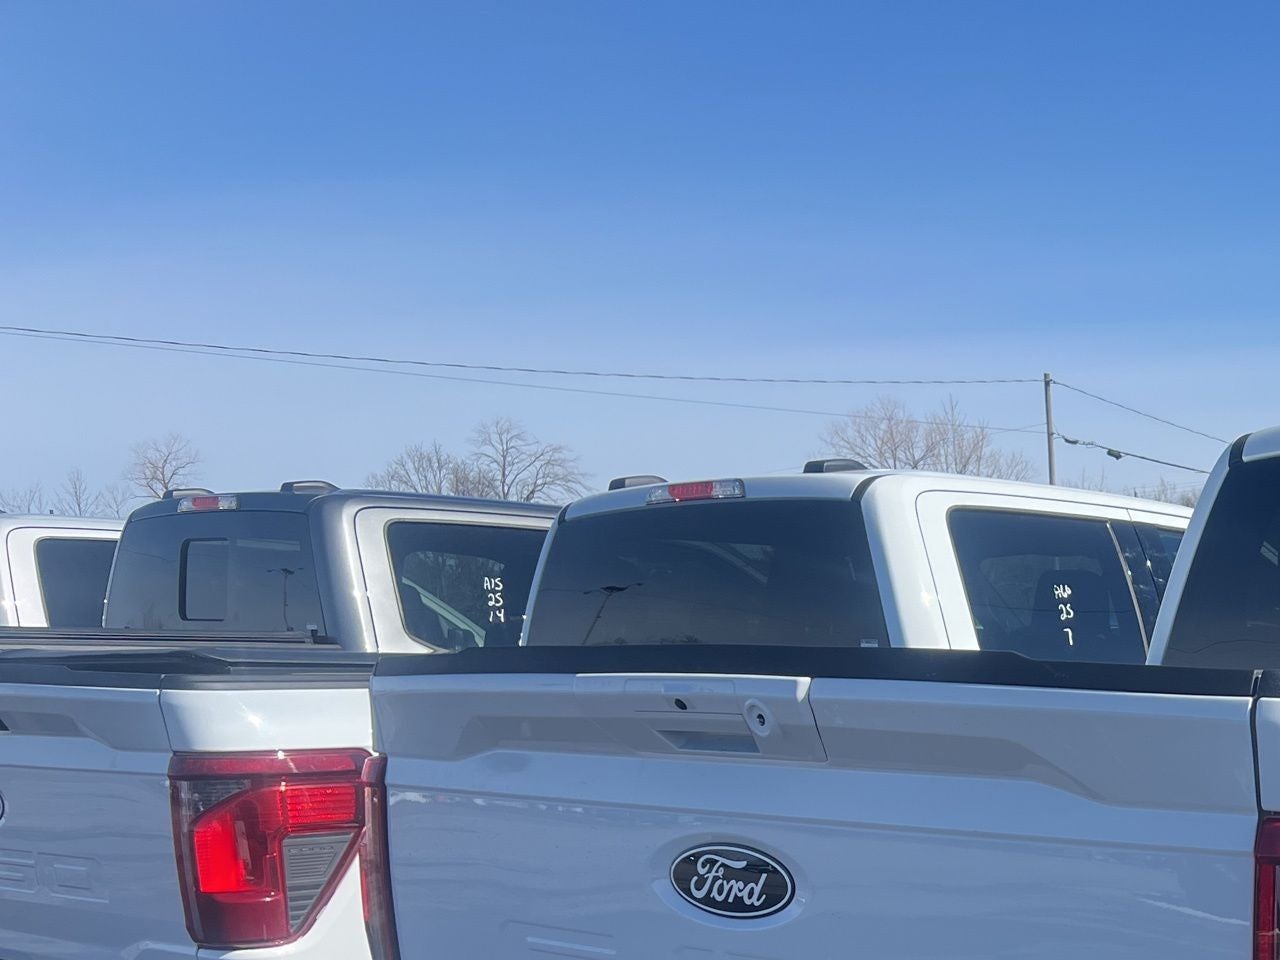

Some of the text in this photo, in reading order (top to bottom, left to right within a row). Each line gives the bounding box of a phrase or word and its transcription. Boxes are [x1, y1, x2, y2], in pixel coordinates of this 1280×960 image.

[487, 592, 504, 607] 25
[489, 608, 505, 623] 14
[1058, 603, 1074, 621] 25
[1063, 627, 1074, 646] 7
[690, 854, 768, 907] Ford
